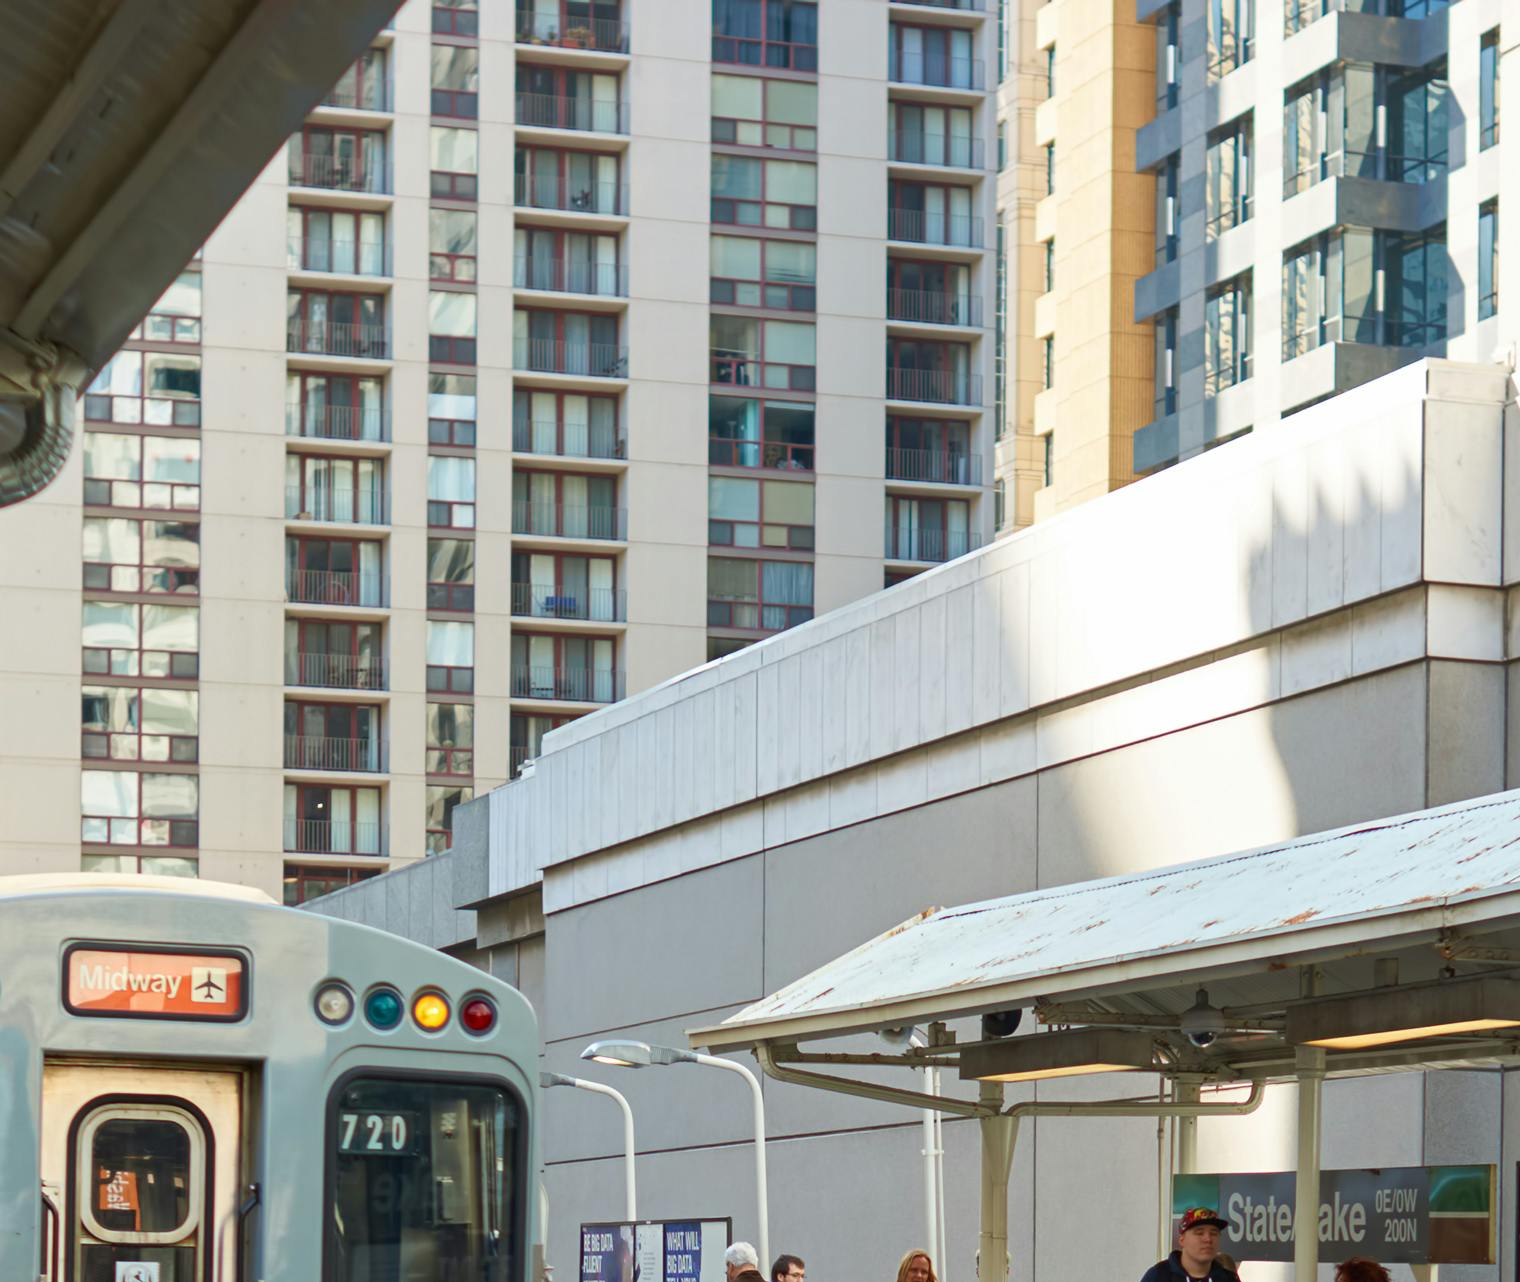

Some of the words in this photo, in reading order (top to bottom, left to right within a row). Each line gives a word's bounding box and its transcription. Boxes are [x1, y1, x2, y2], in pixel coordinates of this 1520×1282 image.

[79, 963, 183, 999] Midway
[340, 1113, 407, 1151] 720
[1227, 1191, 1367, 1243] Stateake
[1384, 1218, 1418, 1243] 200N
[666, 1231, 684, 1251] WHAT
[685, 1231, 700, 1251] WILL
[666, 1254, 677, 1274] BIG
[678, 1254, 693, 1274] DATA
